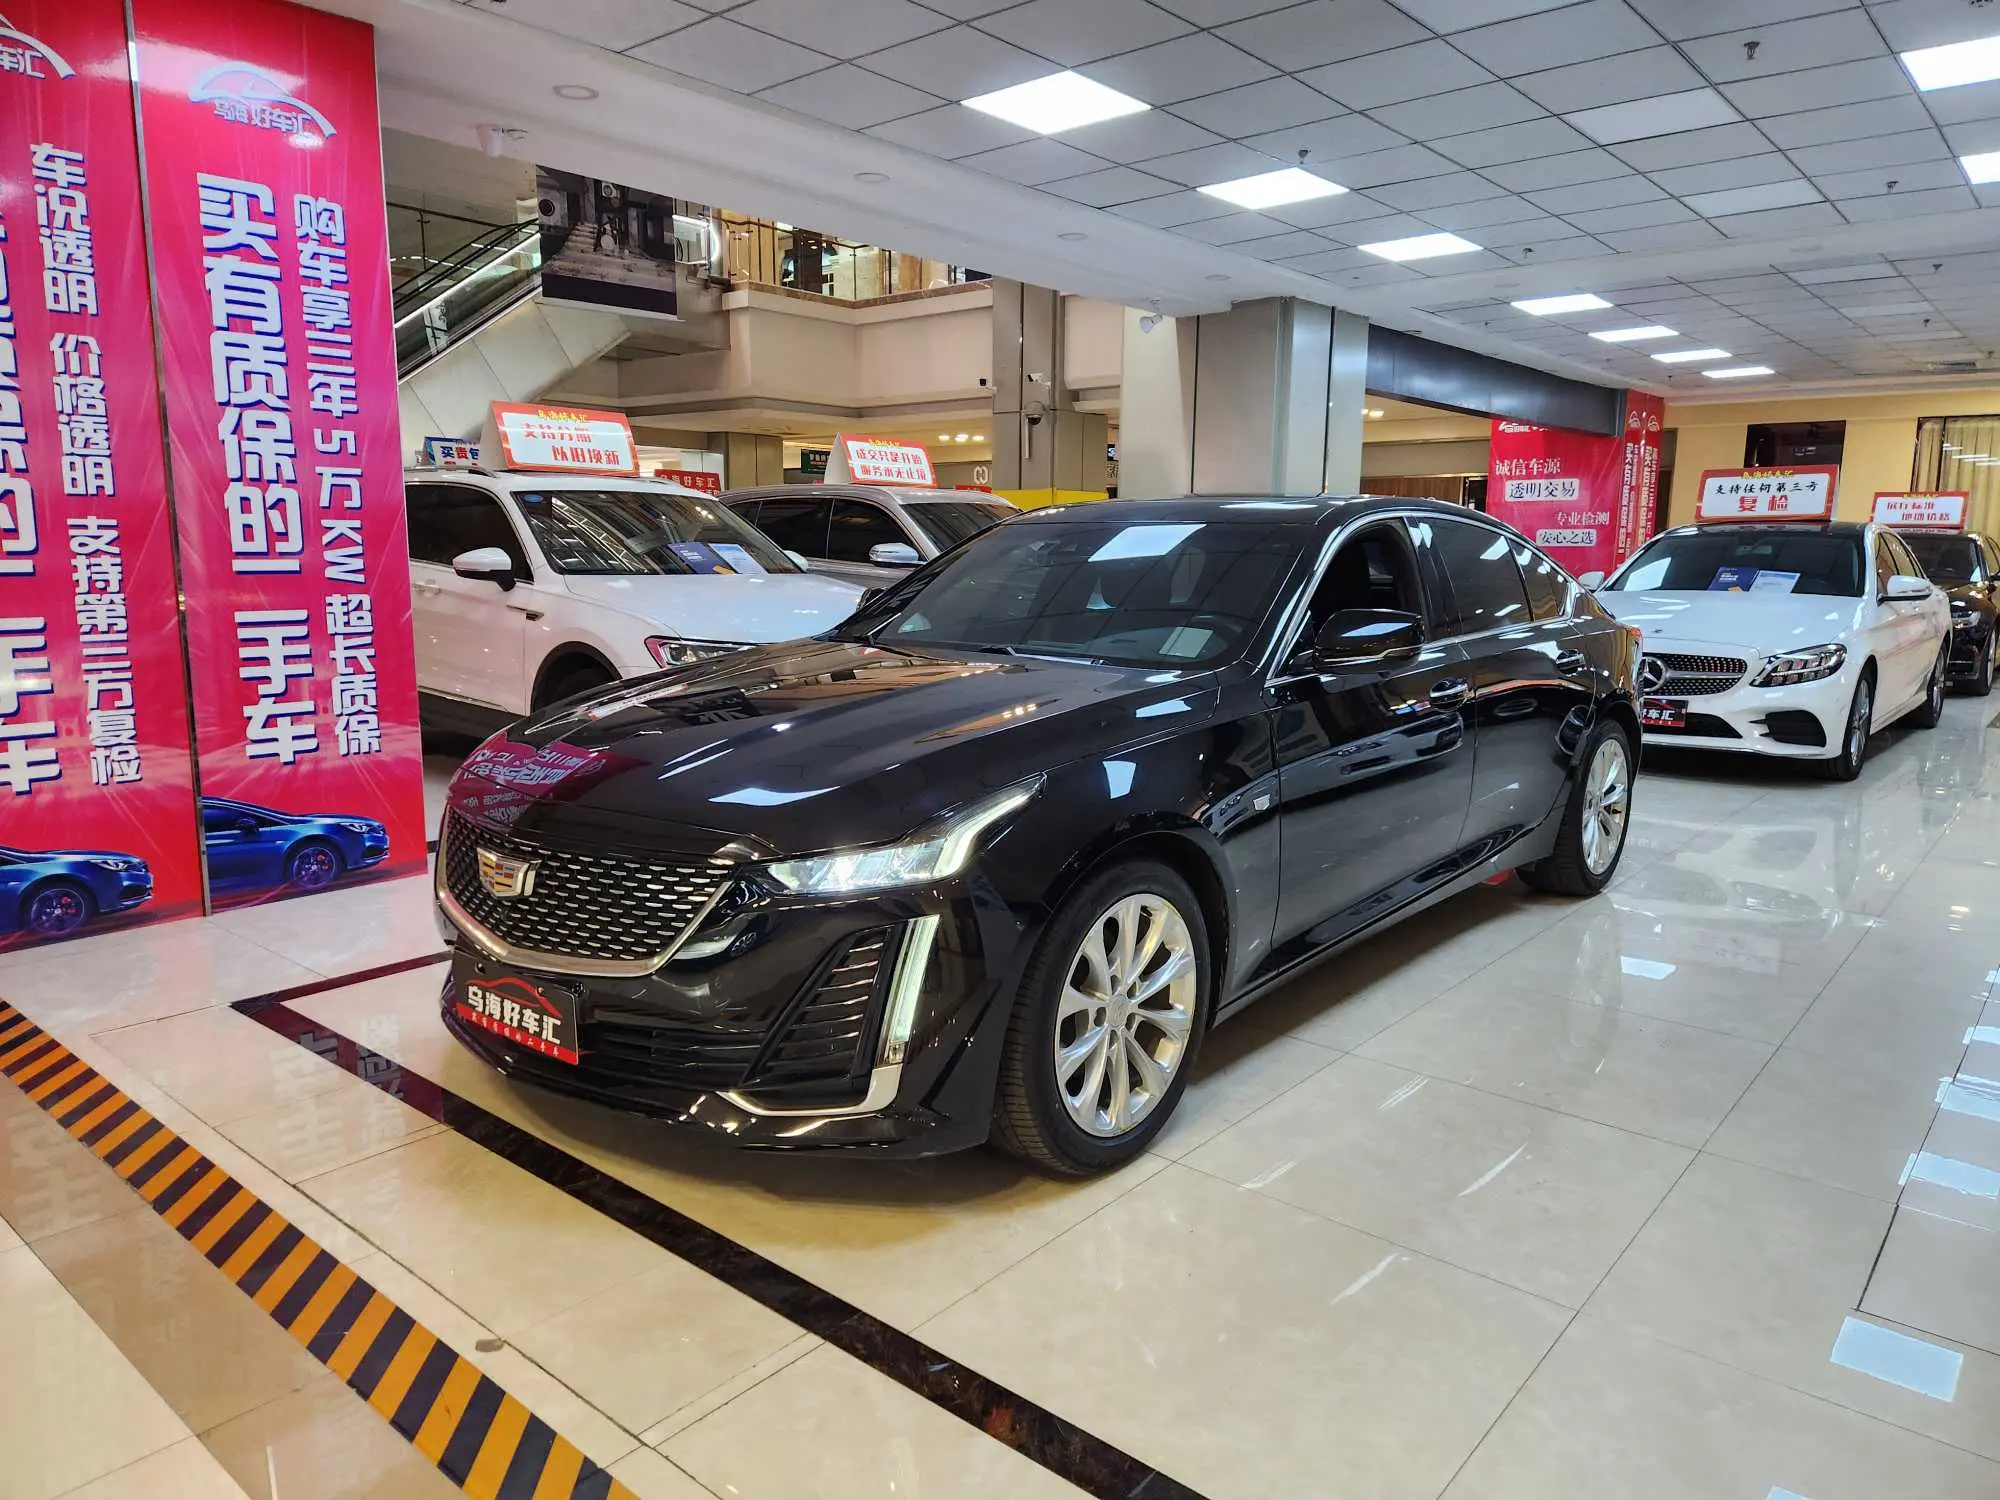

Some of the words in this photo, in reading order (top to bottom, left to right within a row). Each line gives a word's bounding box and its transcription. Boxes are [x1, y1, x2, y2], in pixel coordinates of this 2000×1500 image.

[214, 100, 314, 139] 乌海好车汇
[30, 142, 98, 316] 车况透明
[50, 333, 116, 497] 价格透明
[551, 445, 621, 466] 以旧换新
[197, 172, 319, 765] 买有质保的二手车
[1495, 458, 1561, 476] 诚信车源
[1510, 480, 1576, 499] 透明交易
[1715, 481, 1819, 495] 支持任何第三方
[1738, 495, 1789, 512] 复检
[1557, 511, 1610, 525] 专业检测
[1541, 531, 1594, 545] 安心之选
[66, 515, 143, 785] 支持第三方复检
[467, 985, 561, 1045] 乌海好车汇
